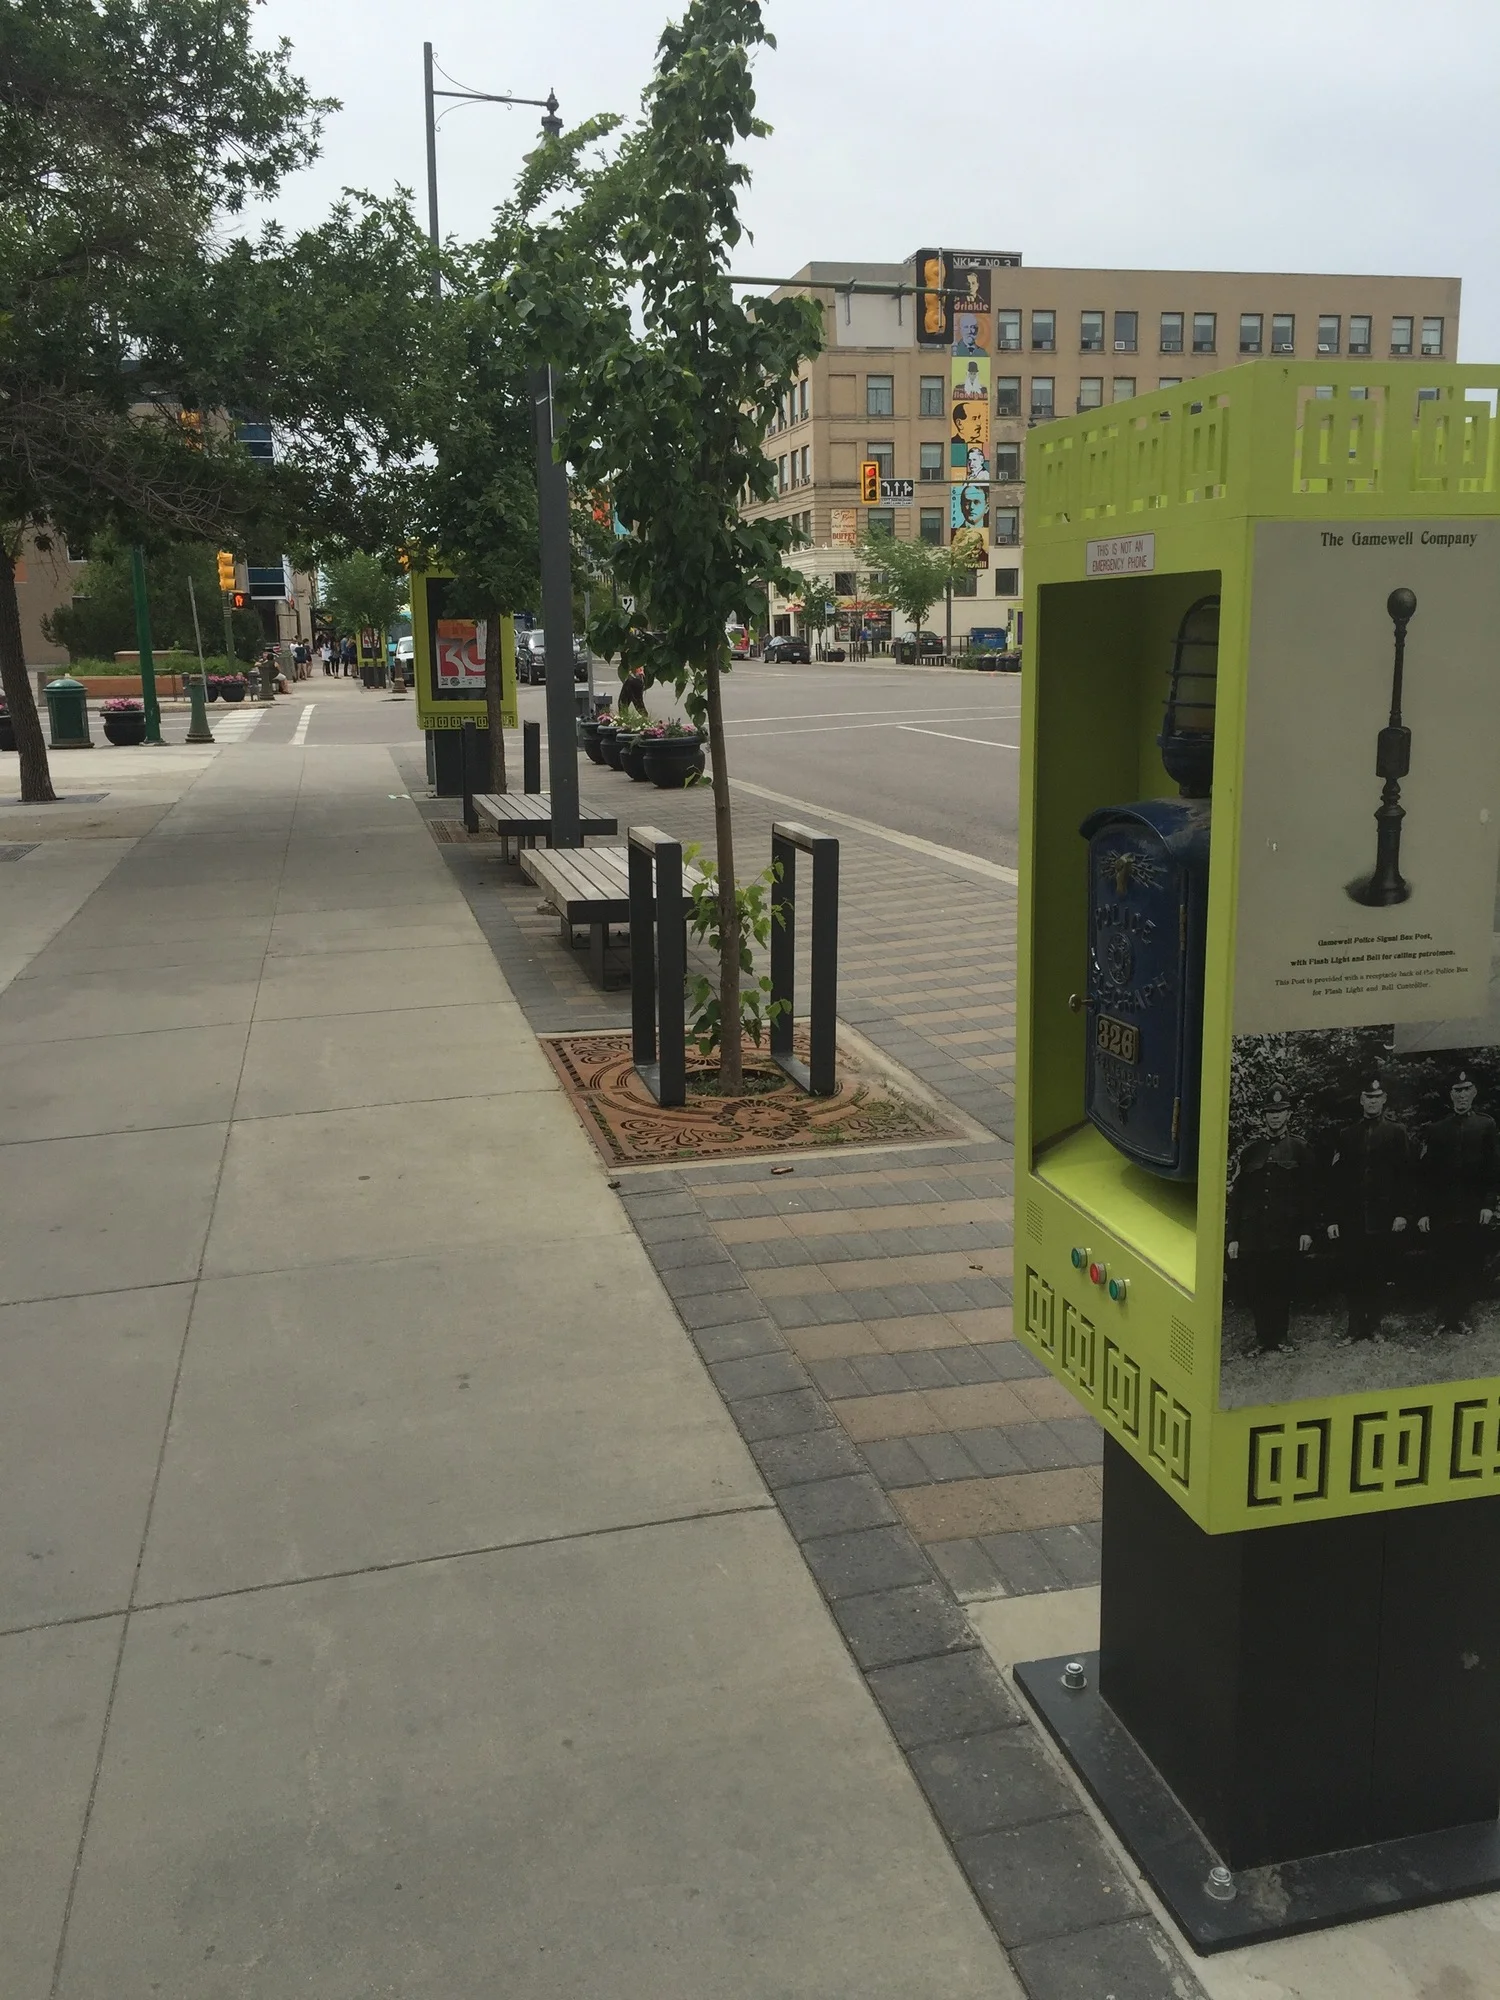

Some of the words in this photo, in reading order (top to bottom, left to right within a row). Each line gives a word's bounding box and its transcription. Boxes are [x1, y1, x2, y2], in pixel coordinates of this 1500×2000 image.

[952, 256, 981, 268] NKLE
[954, 302, 989, 311] drinkle
[1320, 532, 1344, 546] The
[1352, 531, 1414, 546] Gamewell
[1420, 530, 1478, 548] Company
[1096, 544, 1110, 556] THIS
[1112, 542, 1118, 555] IS
[1120, 540, 1132, 554] NOT
[1135, 540, 1144, 552] AN
[1092, 558, 1124, 572] EMERGENCY
[1127, 555, 1147, 569] PHONE
[1318, 937, 1352, 947] Gamewell
[1376, 935, 1398, 943] Signal
[1290, 958, 1307, 966] with
[1309, 957, 1329, 965] Flash
[1330, 956, 1350, 965] Light
[1394, 951, 1417, 960] calling
[1314, 975, 1342, 984] provided
[1346, 986, 1364, 995] Light
